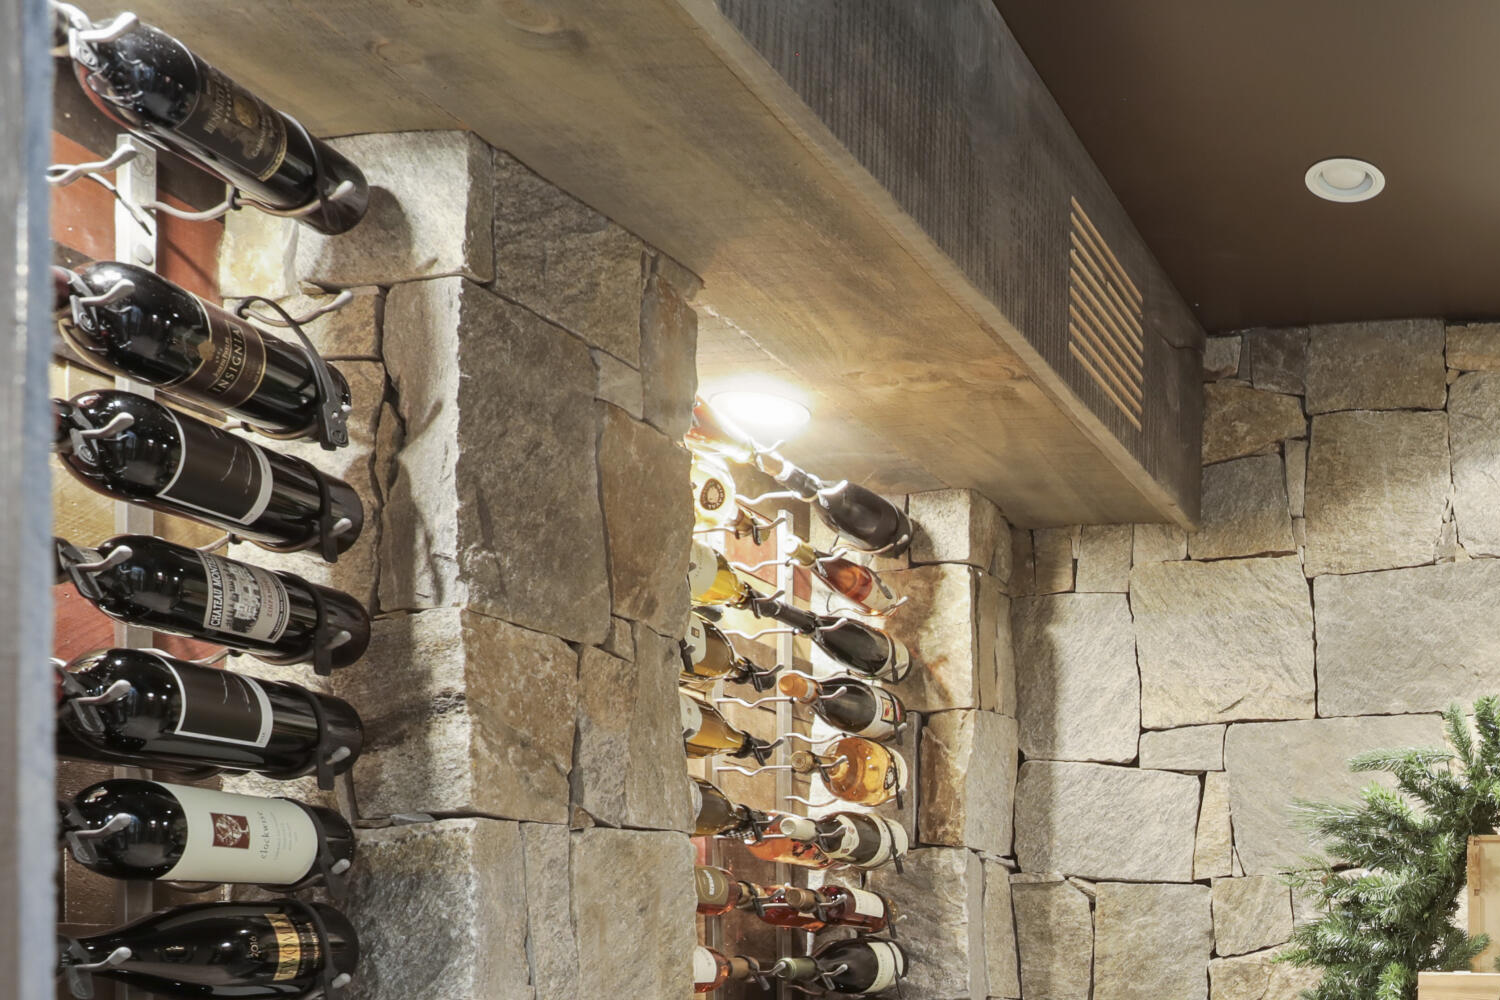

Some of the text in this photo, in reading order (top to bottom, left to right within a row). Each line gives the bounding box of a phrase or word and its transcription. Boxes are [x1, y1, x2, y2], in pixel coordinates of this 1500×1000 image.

[212, 329, 243, 392] INSIGNIA
[210, 590, 223, 626] CHATEAU
[249, 936, 258, 957] 2016
